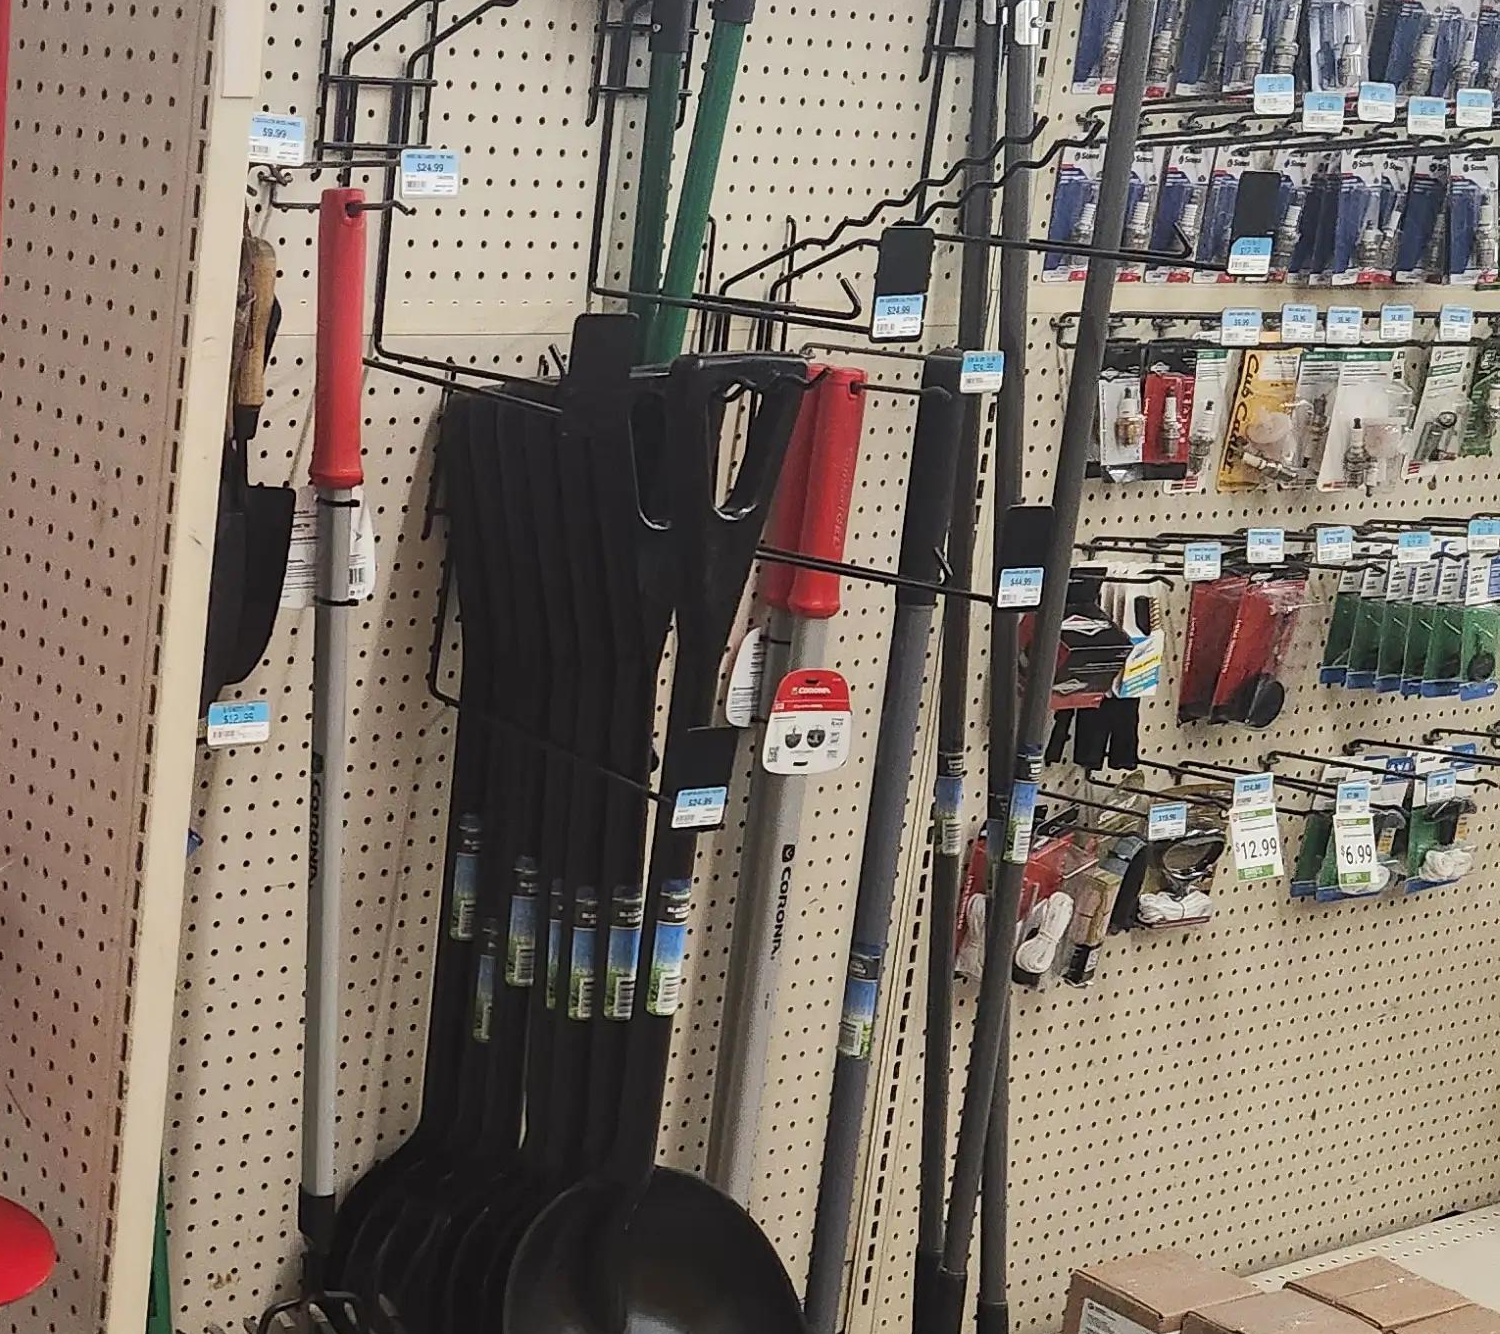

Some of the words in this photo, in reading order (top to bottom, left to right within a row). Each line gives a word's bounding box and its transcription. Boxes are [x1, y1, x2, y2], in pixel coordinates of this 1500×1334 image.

[416, 162, 444, 172] $24.99
[887, 305, 911, 315] $24.99
[1241, 354, 1259, 398] Cub
[1235, 837, 1278, 860] $12.99
[1340, 843, 1372, 866] $6.99
[771, 866, 791, 955] CORONA
